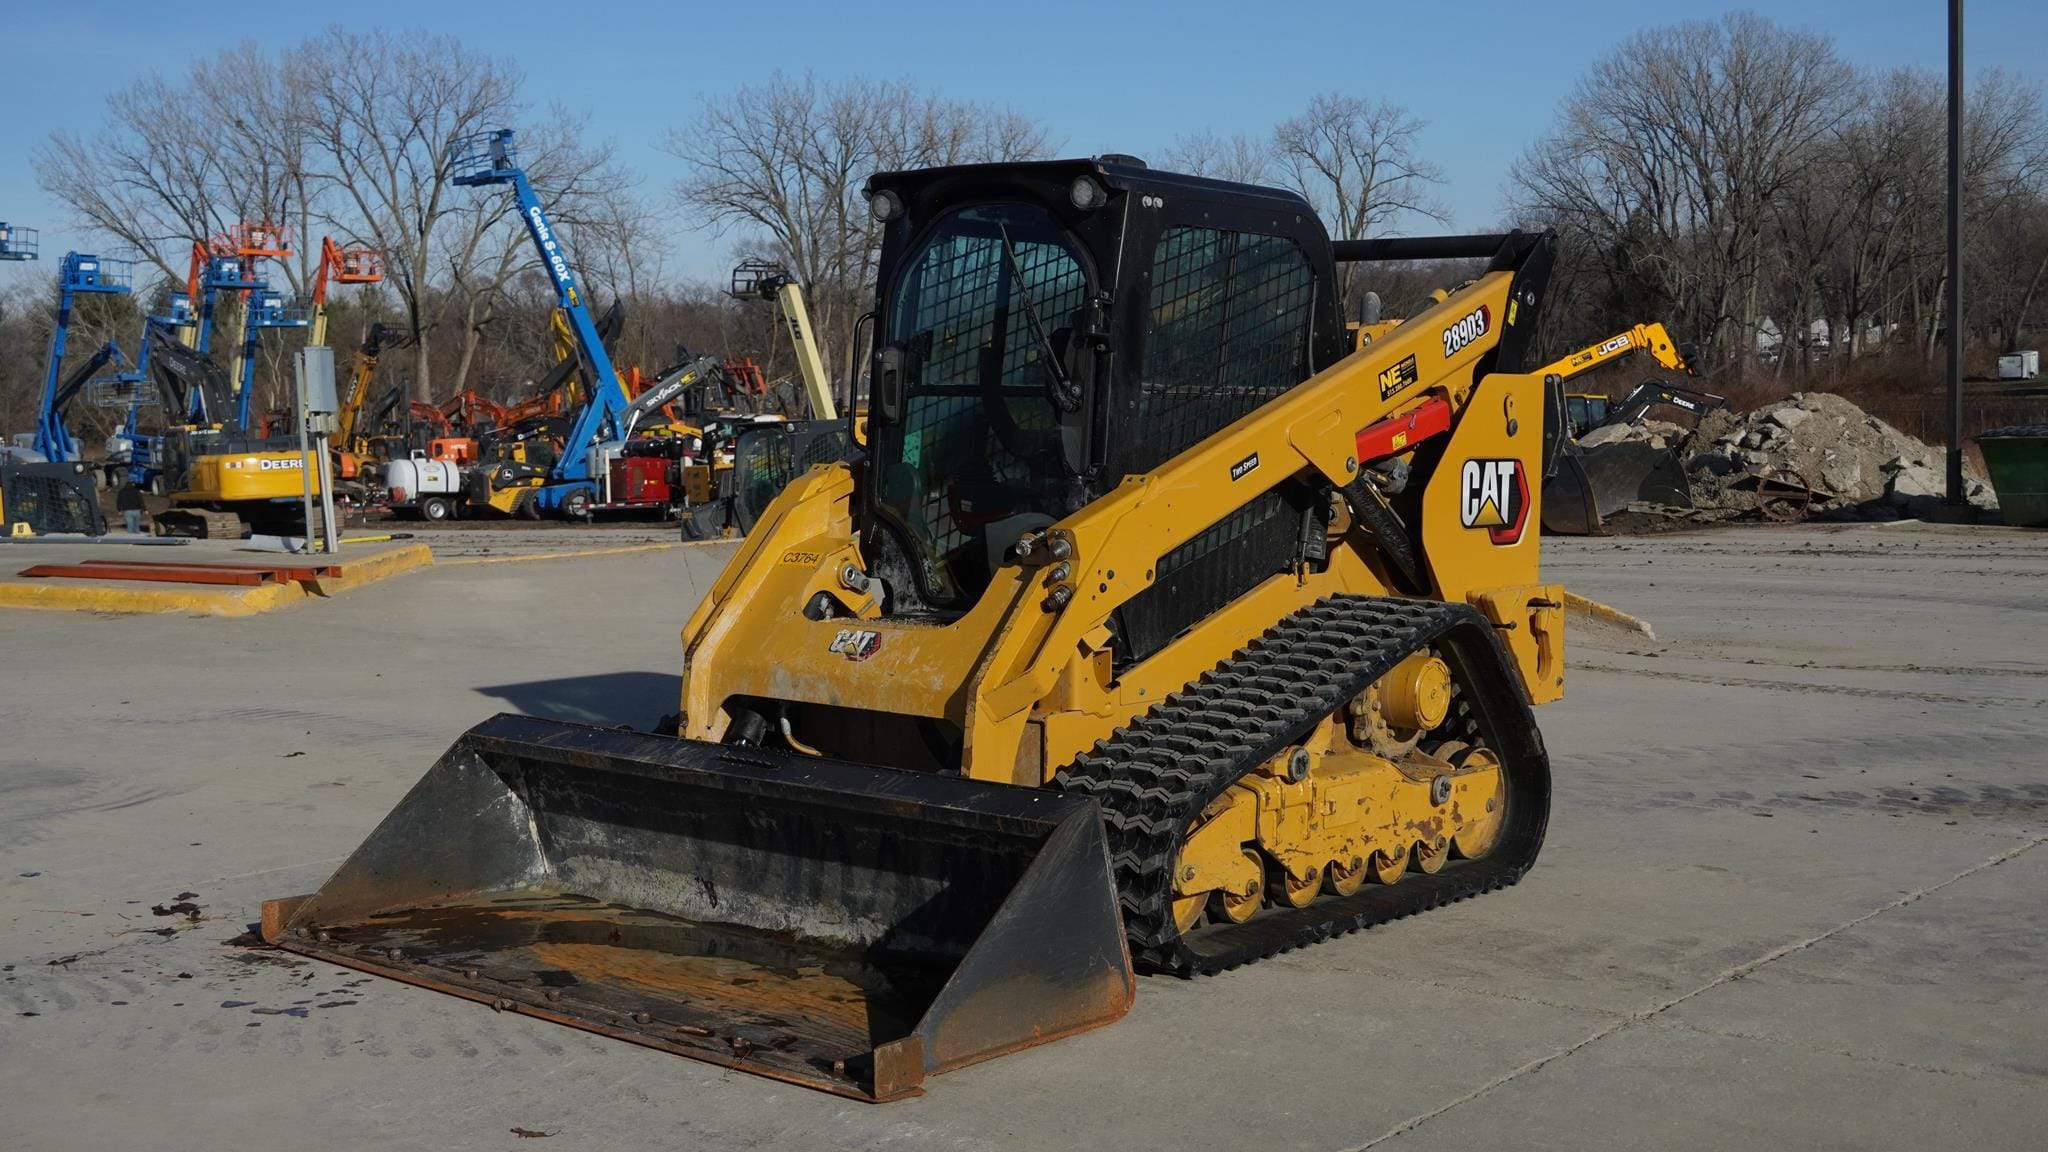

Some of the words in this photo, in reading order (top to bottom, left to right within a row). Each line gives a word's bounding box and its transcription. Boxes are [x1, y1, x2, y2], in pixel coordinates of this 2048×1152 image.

[530, 207, 549, 240] Genie
[545, 241, 570, 281] S-60X
[790, 317, 801, 339] JLG
[1444, 309, 1485, 357] 289D3
[1599, 335, 1629, 355] JCB
[1380, 364, 1402, 392] NE
[646, 382, 682, 407] SKYJACK
[1673, 397, 1695, 409] DEERE
[1462, 461, 1515, 526] CAT
[783, 552, 819, 564] C3764
[829, 630, 878, 657] CAT
